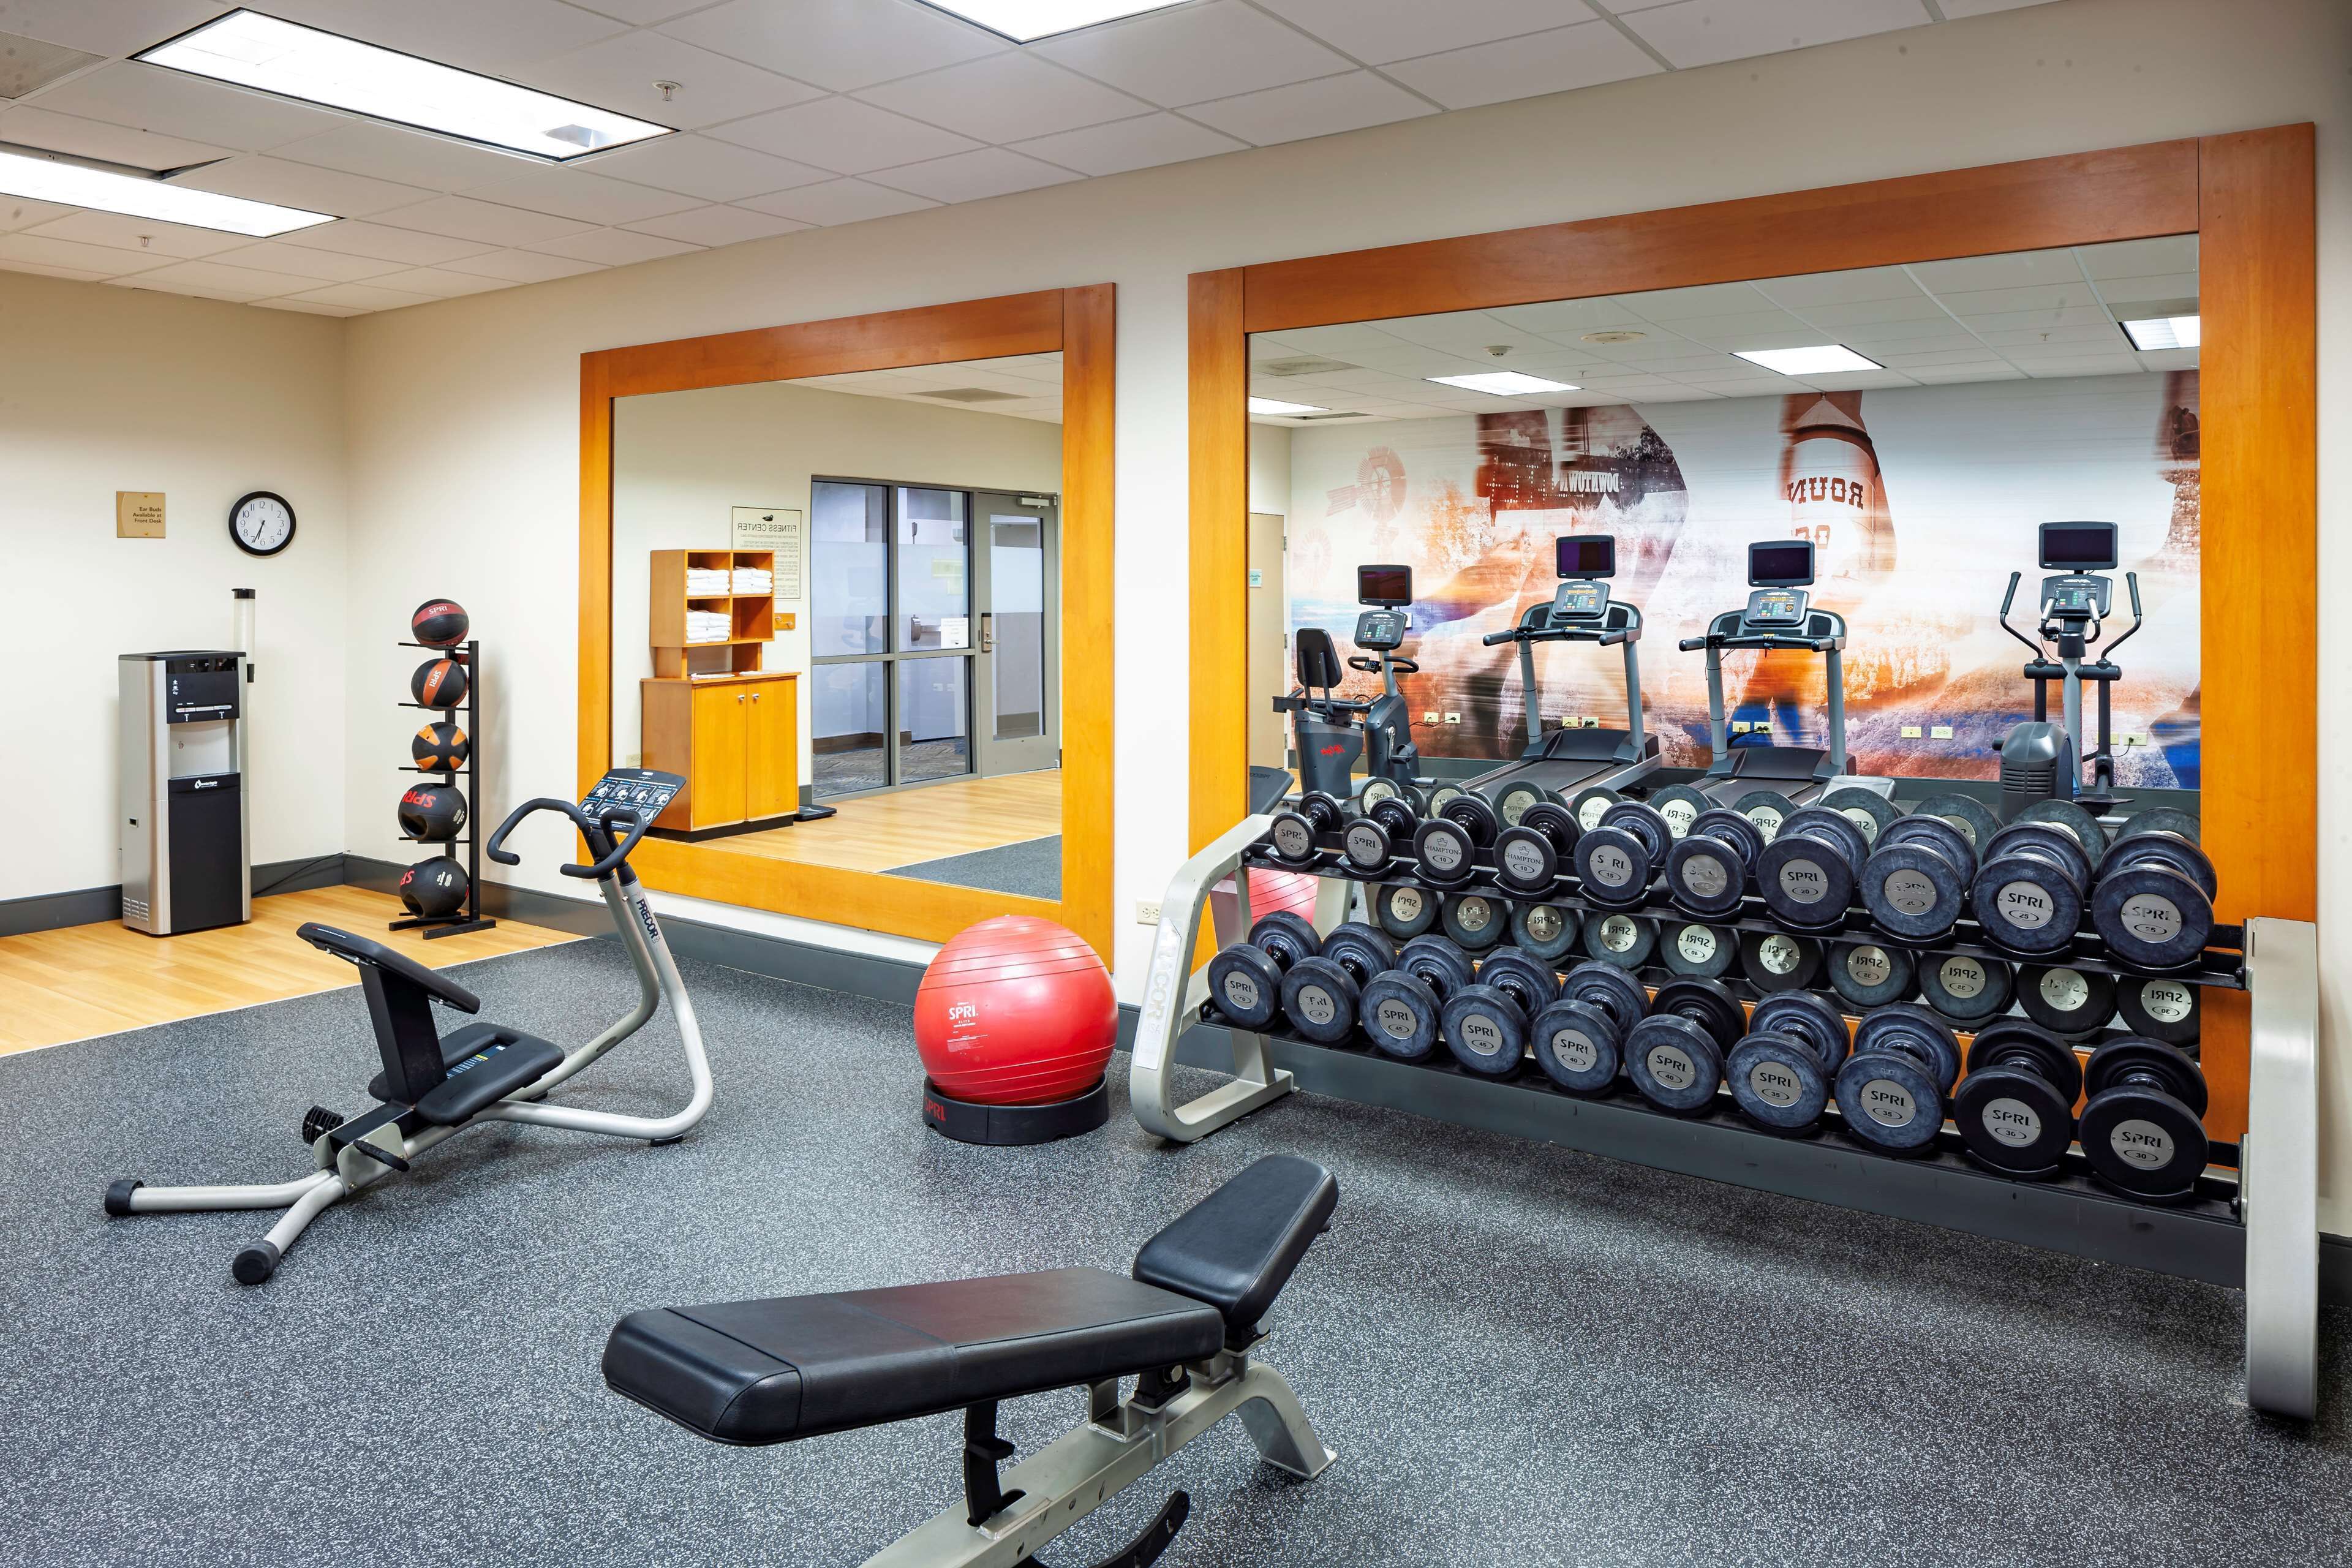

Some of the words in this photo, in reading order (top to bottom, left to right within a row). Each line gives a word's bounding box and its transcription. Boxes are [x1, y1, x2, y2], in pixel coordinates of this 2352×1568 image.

[259, 500, 265, 509] 12
[429, 605, 448, 615] SPRI
[429, 670, 442, 687] SPRI
[1426, 845, 1460, 855] HAMPTON
[1508, 853, 1542, 865] HAMPTON
[1597, 854, 1624, 870] SRI
[1787, 872, 1819, 882] SPRI
[2007, 892, 2043, 910] SPRI
[636, 898, 658, 939] PRECOR
[2131, 907, 2170, 922] SPRI
[1230, 979, 1252, 993] SPRI
[1306, 996, 1327, 1006] PRI
[949, 1005, 976, 1020] SPRI
[1384, 1009, 1409, 1021] SPRI
[1468, 1024, 1493, 1037] SPRI
[1560, 1038, 1589, 1055] SPRI
[1656, 1054, 1686, 1072] SPRI
[1759, 1072, 1792, 1088] SPRI
[1870, 1090, 1905, 1106] SPRI
[924, 1097, 945, 1120] SPRI
[1992, 1109, 2030, 1126] SPRI
[2121, 1131, 2162, 1148] SPRI
